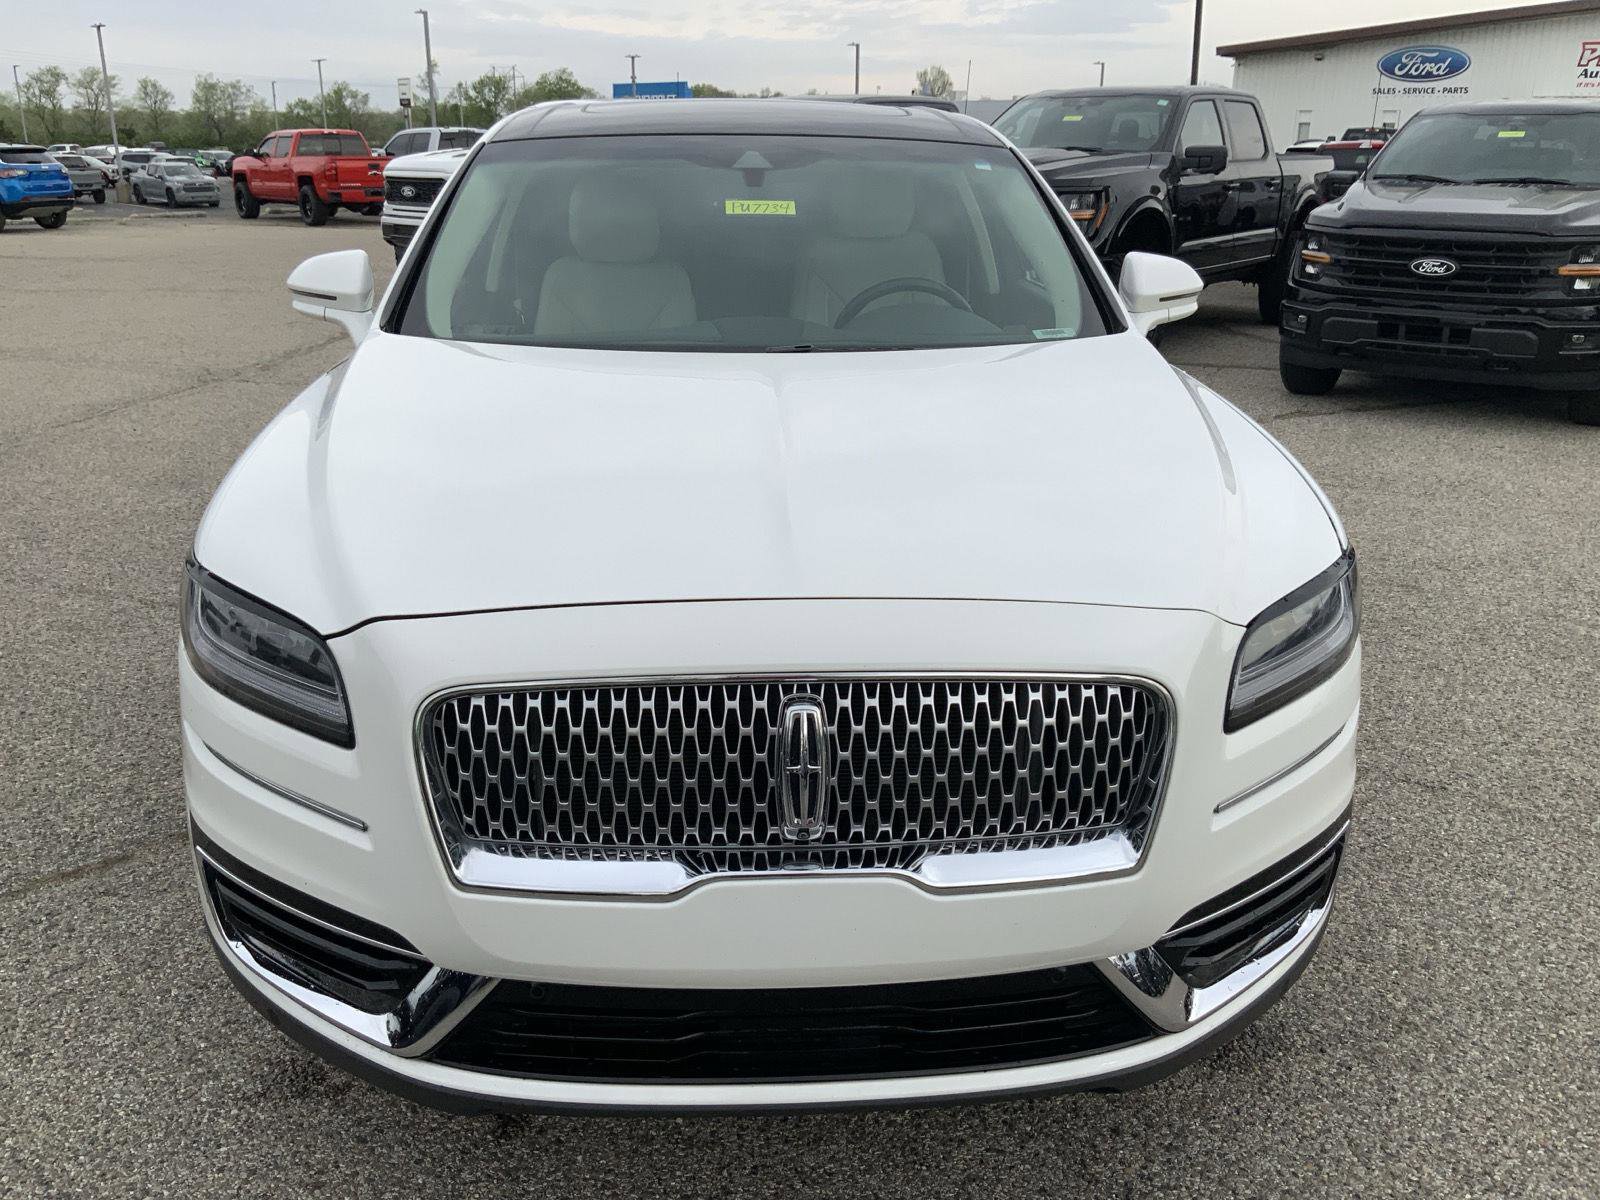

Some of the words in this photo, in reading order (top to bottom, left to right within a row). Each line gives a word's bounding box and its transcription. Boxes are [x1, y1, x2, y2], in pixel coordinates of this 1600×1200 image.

[1394, 51, 1452, 75] Ford
[1577, 68, 1600, 79] Au
[1372, 87, 1396, 95] SALES
[1402, 87, 1436, 95] SERVICE
[1442, 86, 1469, 94] PARTS
[1419, 261, 1447, 273] Ford
